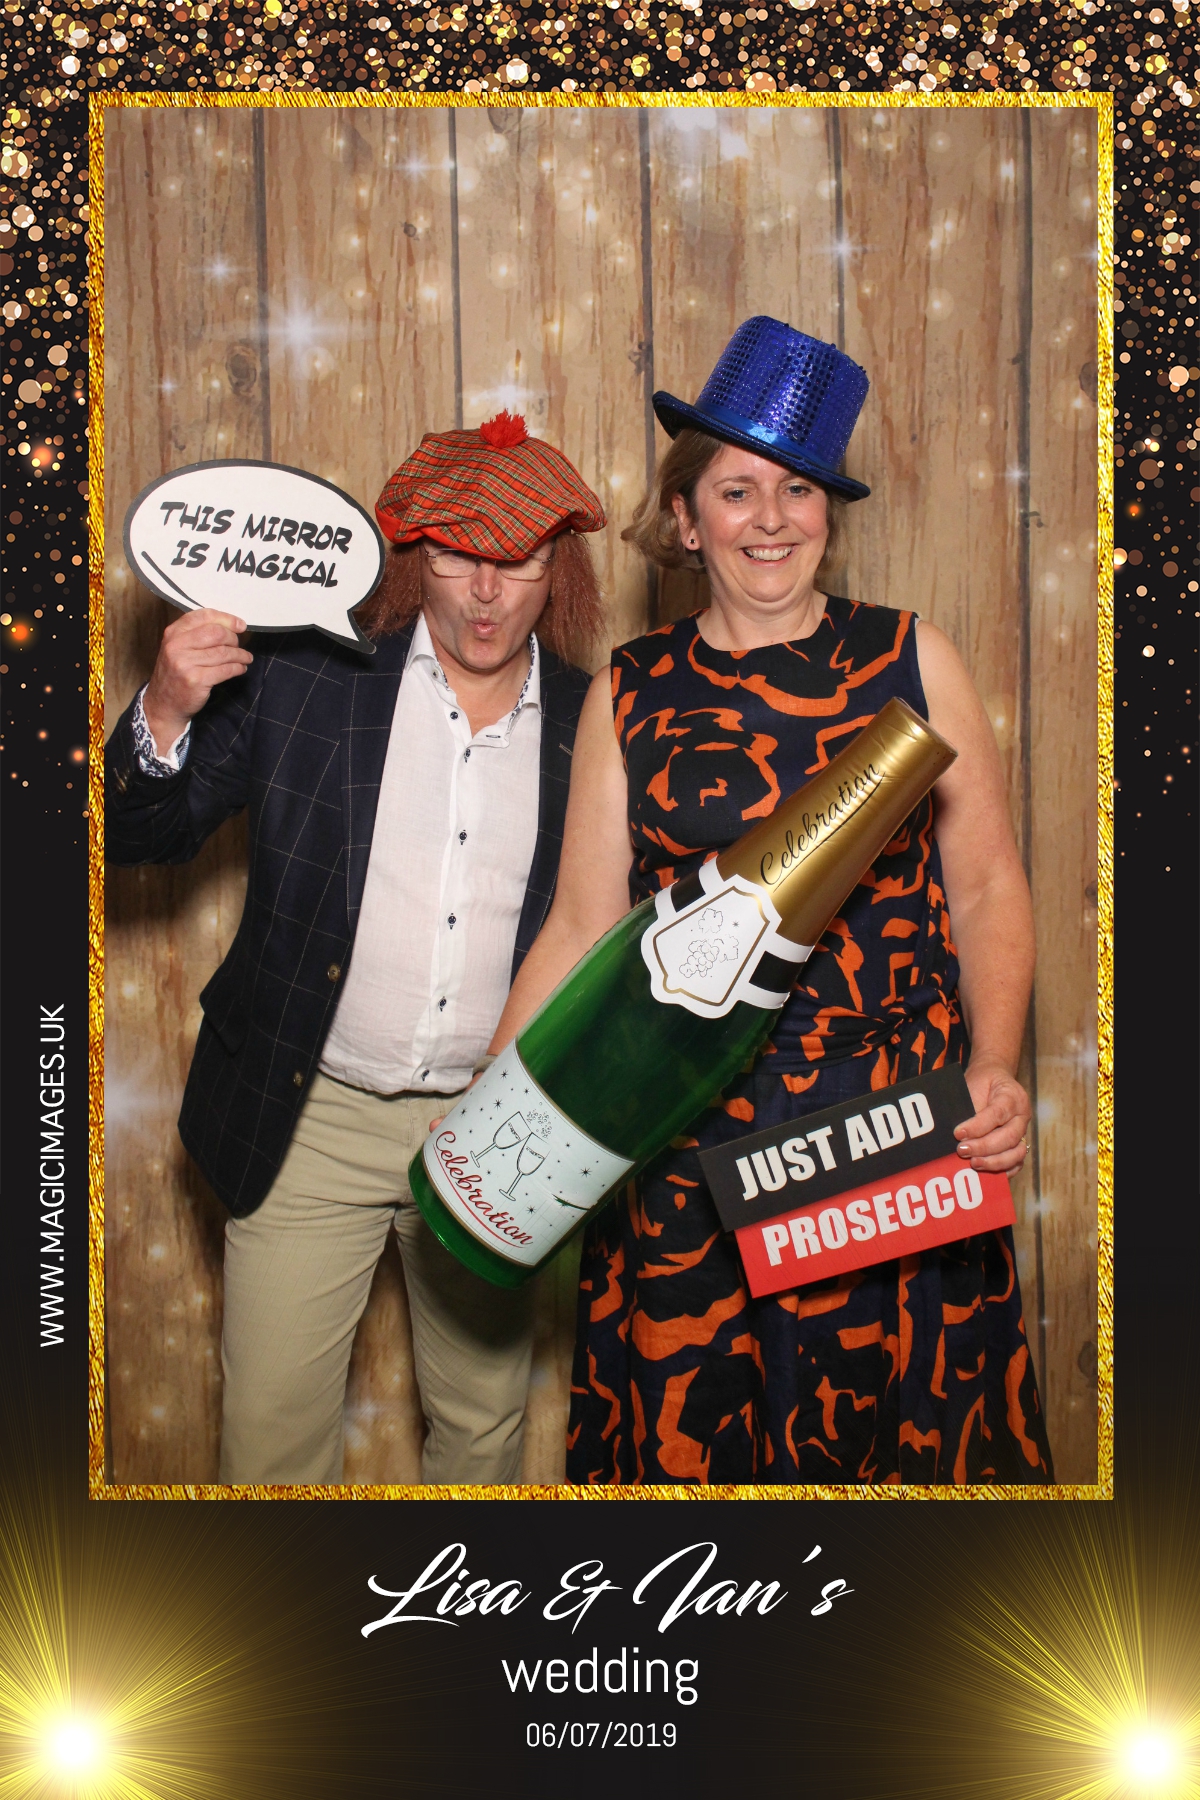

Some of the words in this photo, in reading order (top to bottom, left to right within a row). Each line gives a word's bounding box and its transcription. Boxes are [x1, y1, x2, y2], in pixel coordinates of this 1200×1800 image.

[160, 501, 235, 535] THIS
[241, 513, 353, 555] MIRROR
[171, 540, 210, 568] IS
[217, 547, 338, 588] MAGICAL
[760, 762, 880, 886] Celebration
[435, 1130, 534, 1246] Celebration
[735, 1126, 837, 1201] JUST
[844, 1092, 935, 1162] ADD
[761, 1168, 984, 1267] PROSECCO
